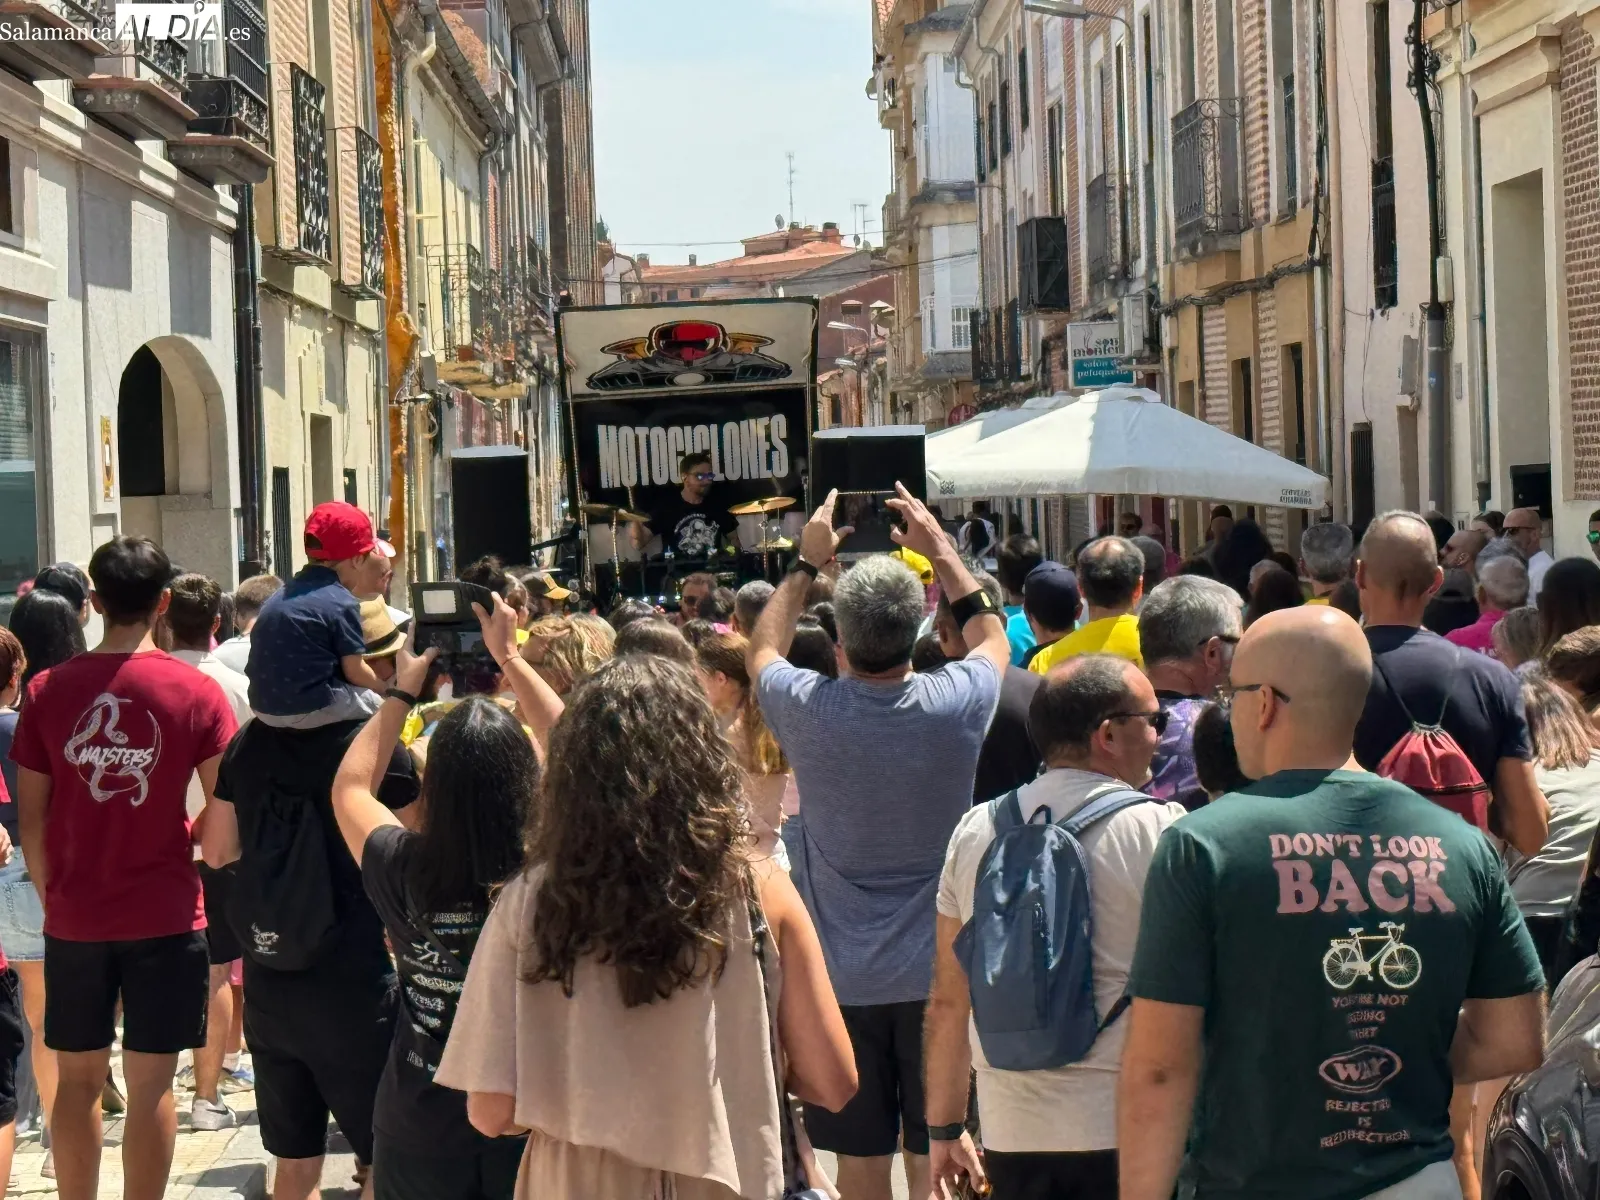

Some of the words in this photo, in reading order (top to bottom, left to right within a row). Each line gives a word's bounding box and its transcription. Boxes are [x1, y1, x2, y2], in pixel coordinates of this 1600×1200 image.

[1269, 832, 1363, 858] DON'T
[1369, 835, 1448, 860] LOOK
[1272, 858, 1457, 914] BACK
[1376, 993, 1409, 1006] NOT
[1332, 1057, 1388, 1081] WAY
